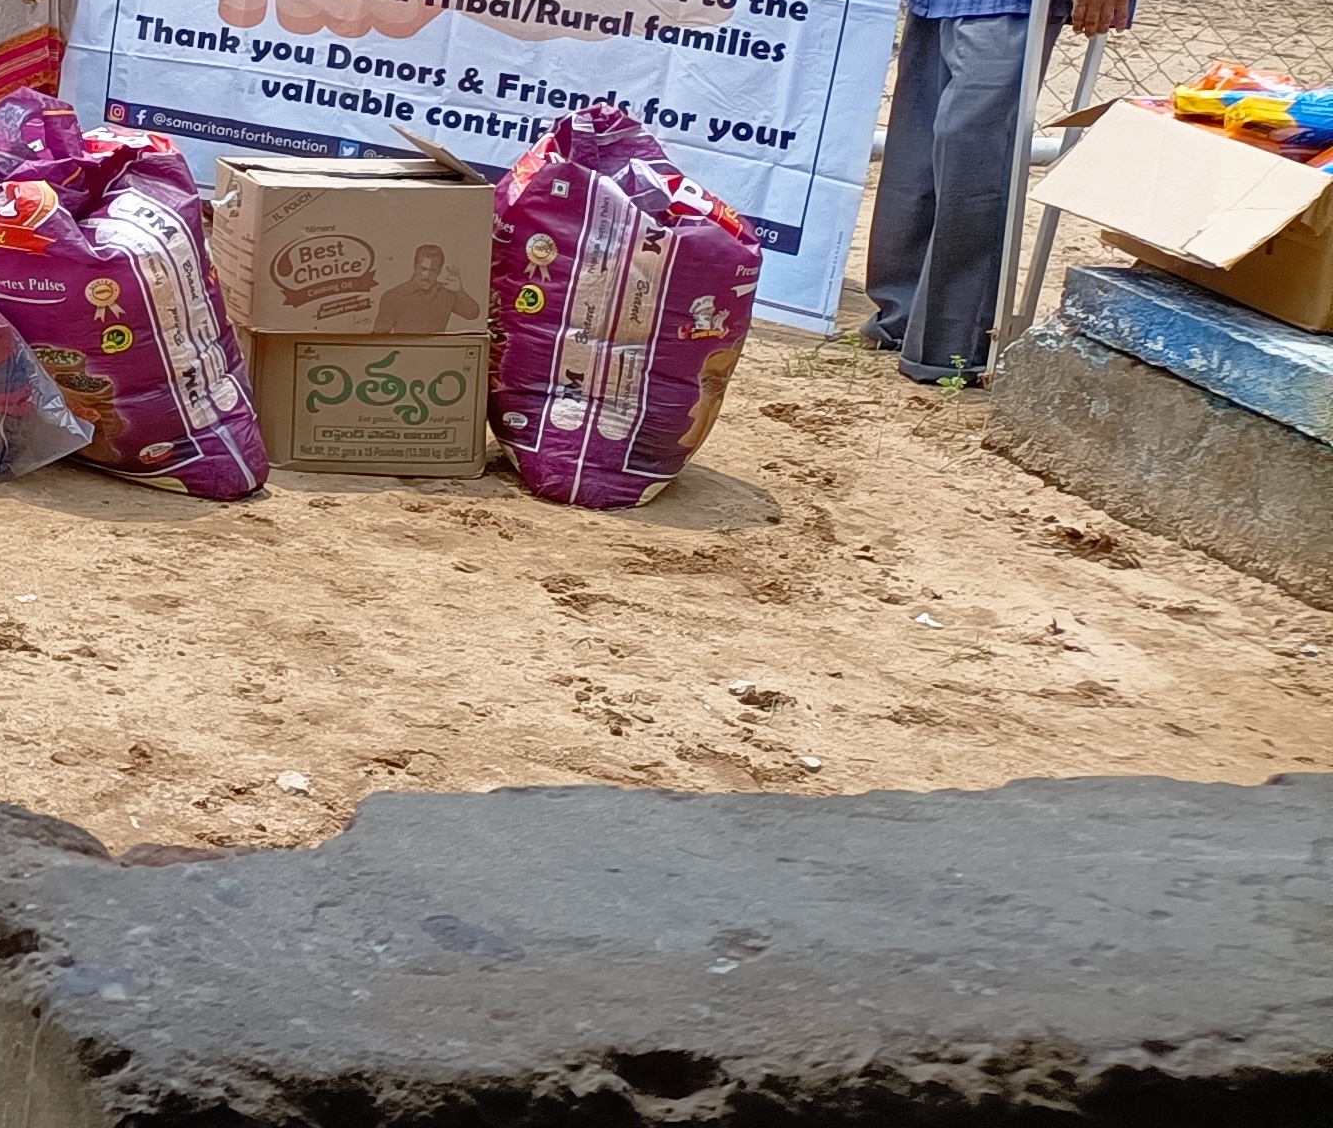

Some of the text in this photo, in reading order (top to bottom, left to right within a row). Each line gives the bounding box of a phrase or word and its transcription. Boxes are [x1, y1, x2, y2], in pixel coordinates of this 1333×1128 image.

[643, 15, 787, 63] families
[136, 14, 241, 54] Thank
[250, 39, 314, 65] you
[326, 43, 447, 88] Donors
[457, 67, 484, 95] &
[643, 98, 697, 133] for
[706, 117, 797, 150] your
[261, 79, 414, 122] valuable
[152, 112, 328, 154] @samaritansforthenation
[283, 191, 313, 215] POUCH
[133, 206, 181, 241] PM
[293, 257, 363, 284] Choice
[298, 240, 345, 264] Best
[29, 278, 66, 292] Pulses
[183, 260, 199, 301] Brand
